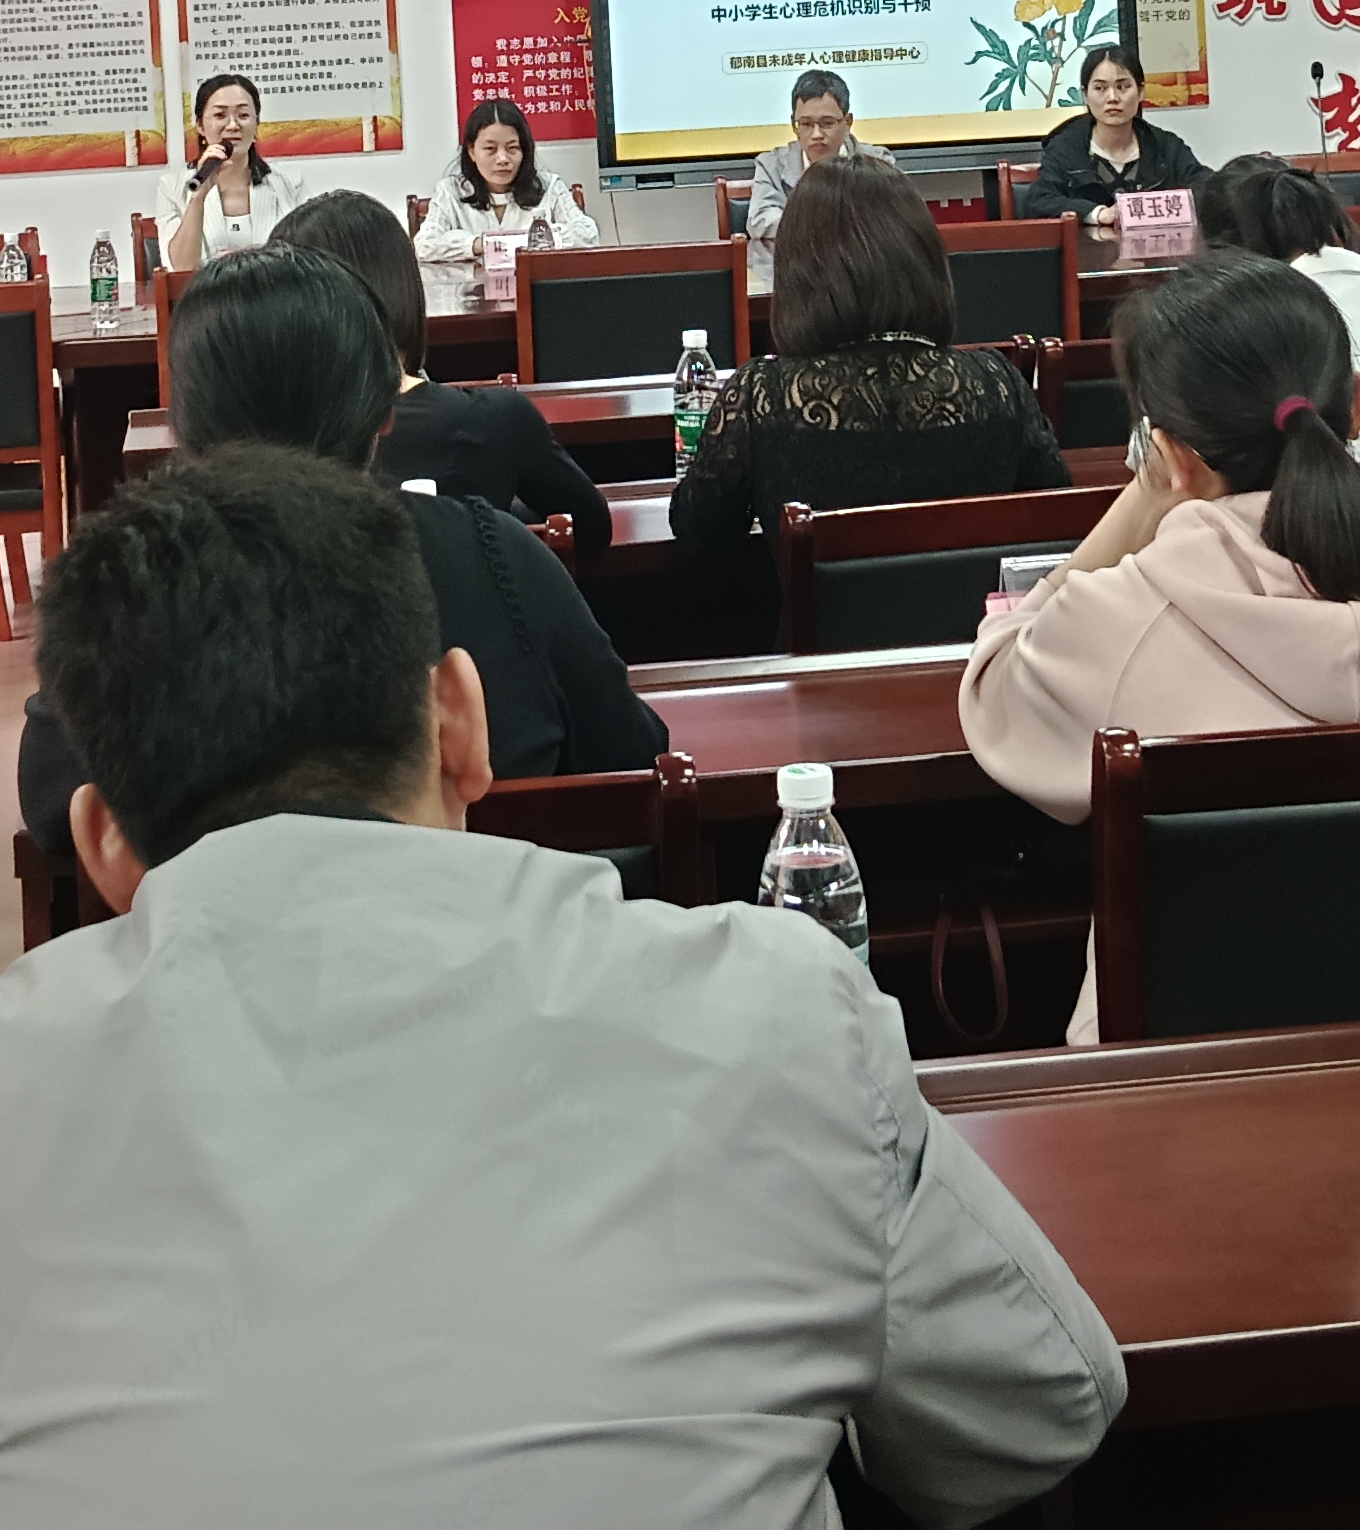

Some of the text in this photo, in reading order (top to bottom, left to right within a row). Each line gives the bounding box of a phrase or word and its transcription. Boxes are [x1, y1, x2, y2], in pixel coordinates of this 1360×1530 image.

[728, 46, 921, 70] 郁南县未成年人心理健康指导中心
